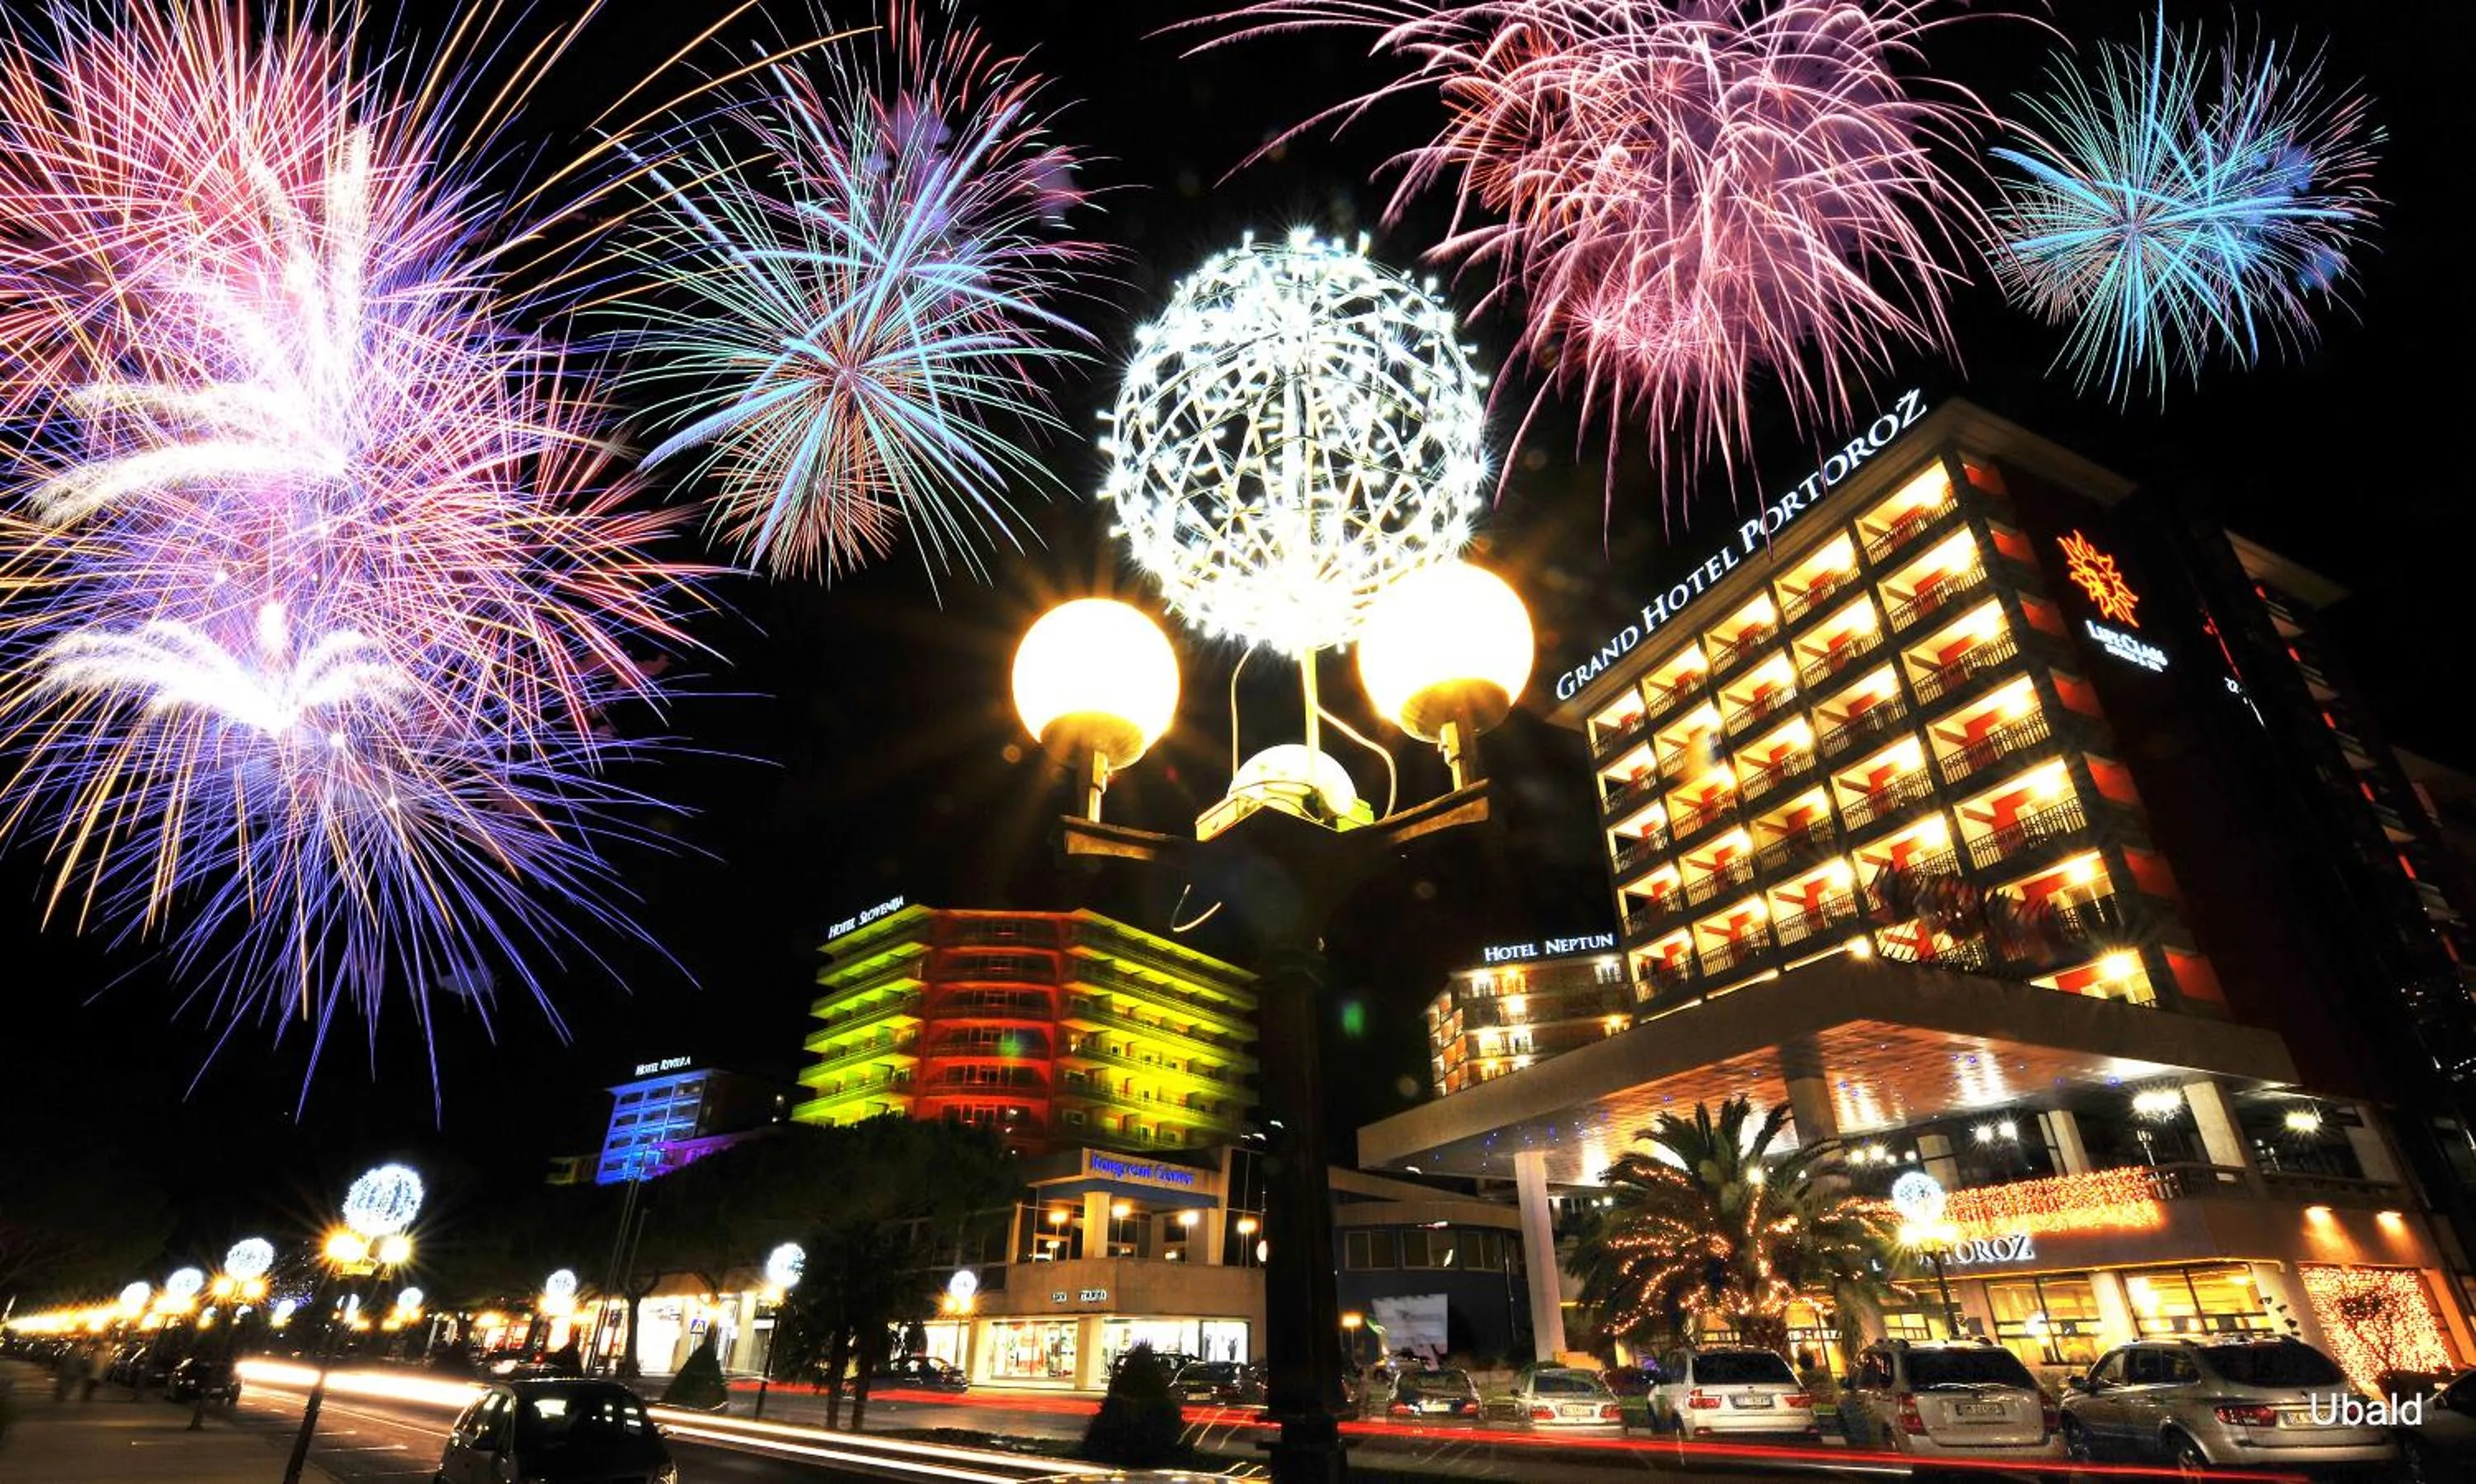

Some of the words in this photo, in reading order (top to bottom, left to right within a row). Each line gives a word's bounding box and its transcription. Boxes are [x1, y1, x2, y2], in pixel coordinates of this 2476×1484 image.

[1556, 625, 1639, 702] GRAND
[1641, 548, 1739, 635] HOTEL
[1738, 387, 1928, 554] PORTOROŽ
[1484, 943, 1538, 962] HOTEL
[1545, 932, 1614, 955] NEPTUN
